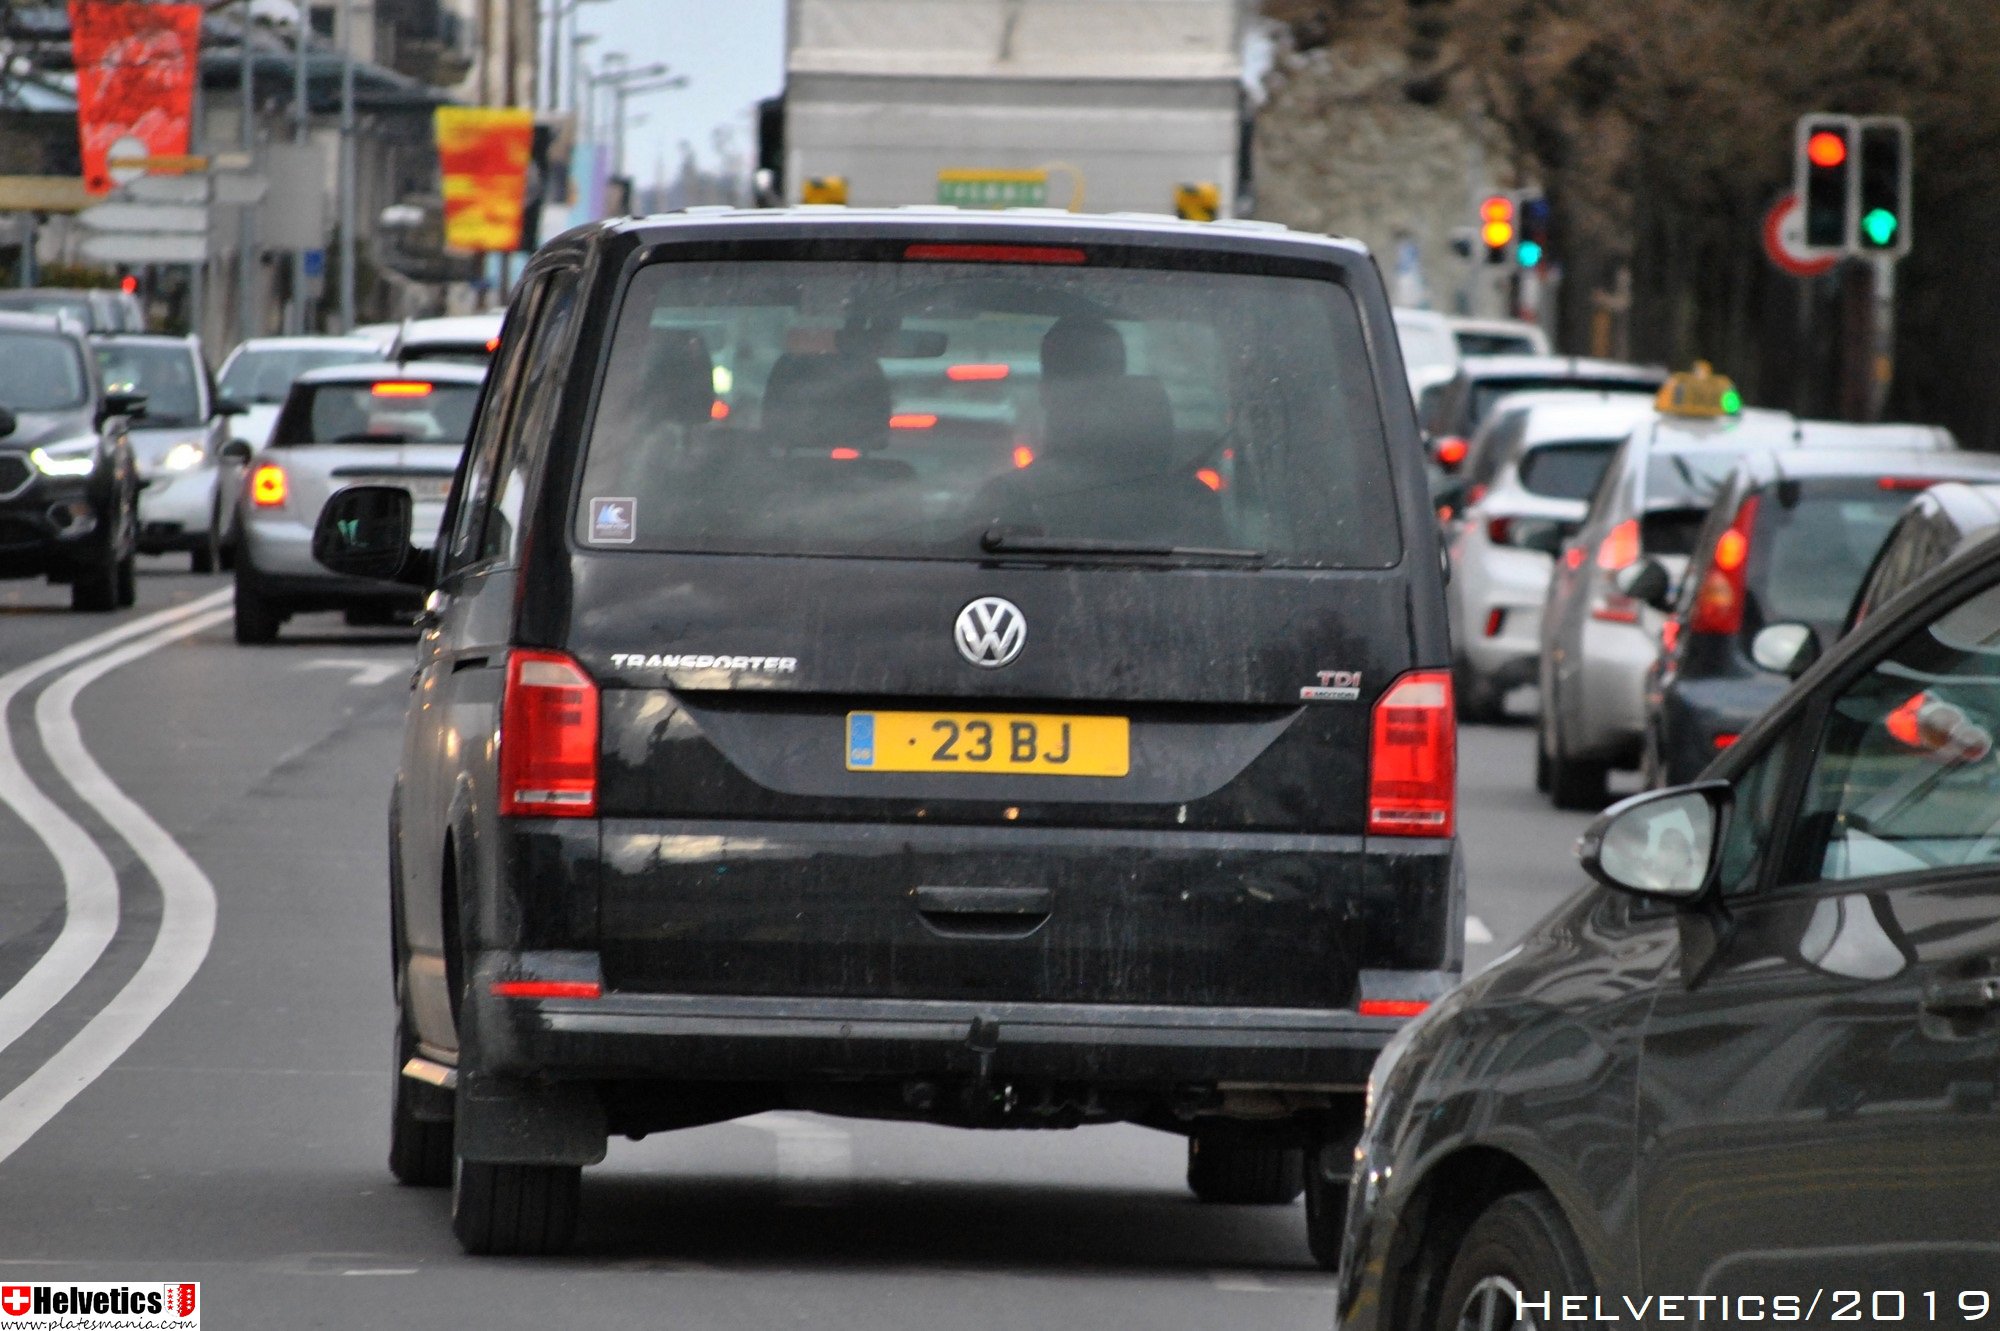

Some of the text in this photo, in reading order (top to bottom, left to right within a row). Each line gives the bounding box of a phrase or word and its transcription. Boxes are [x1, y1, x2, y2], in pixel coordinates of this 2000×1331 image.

[955, 597, 1027, 667] VW
[611, 654, 797, 674] TRANSPORTER
[1316, 670, 1362, 687] TDI
[931, 720, 1071, 764] 23 BJ
